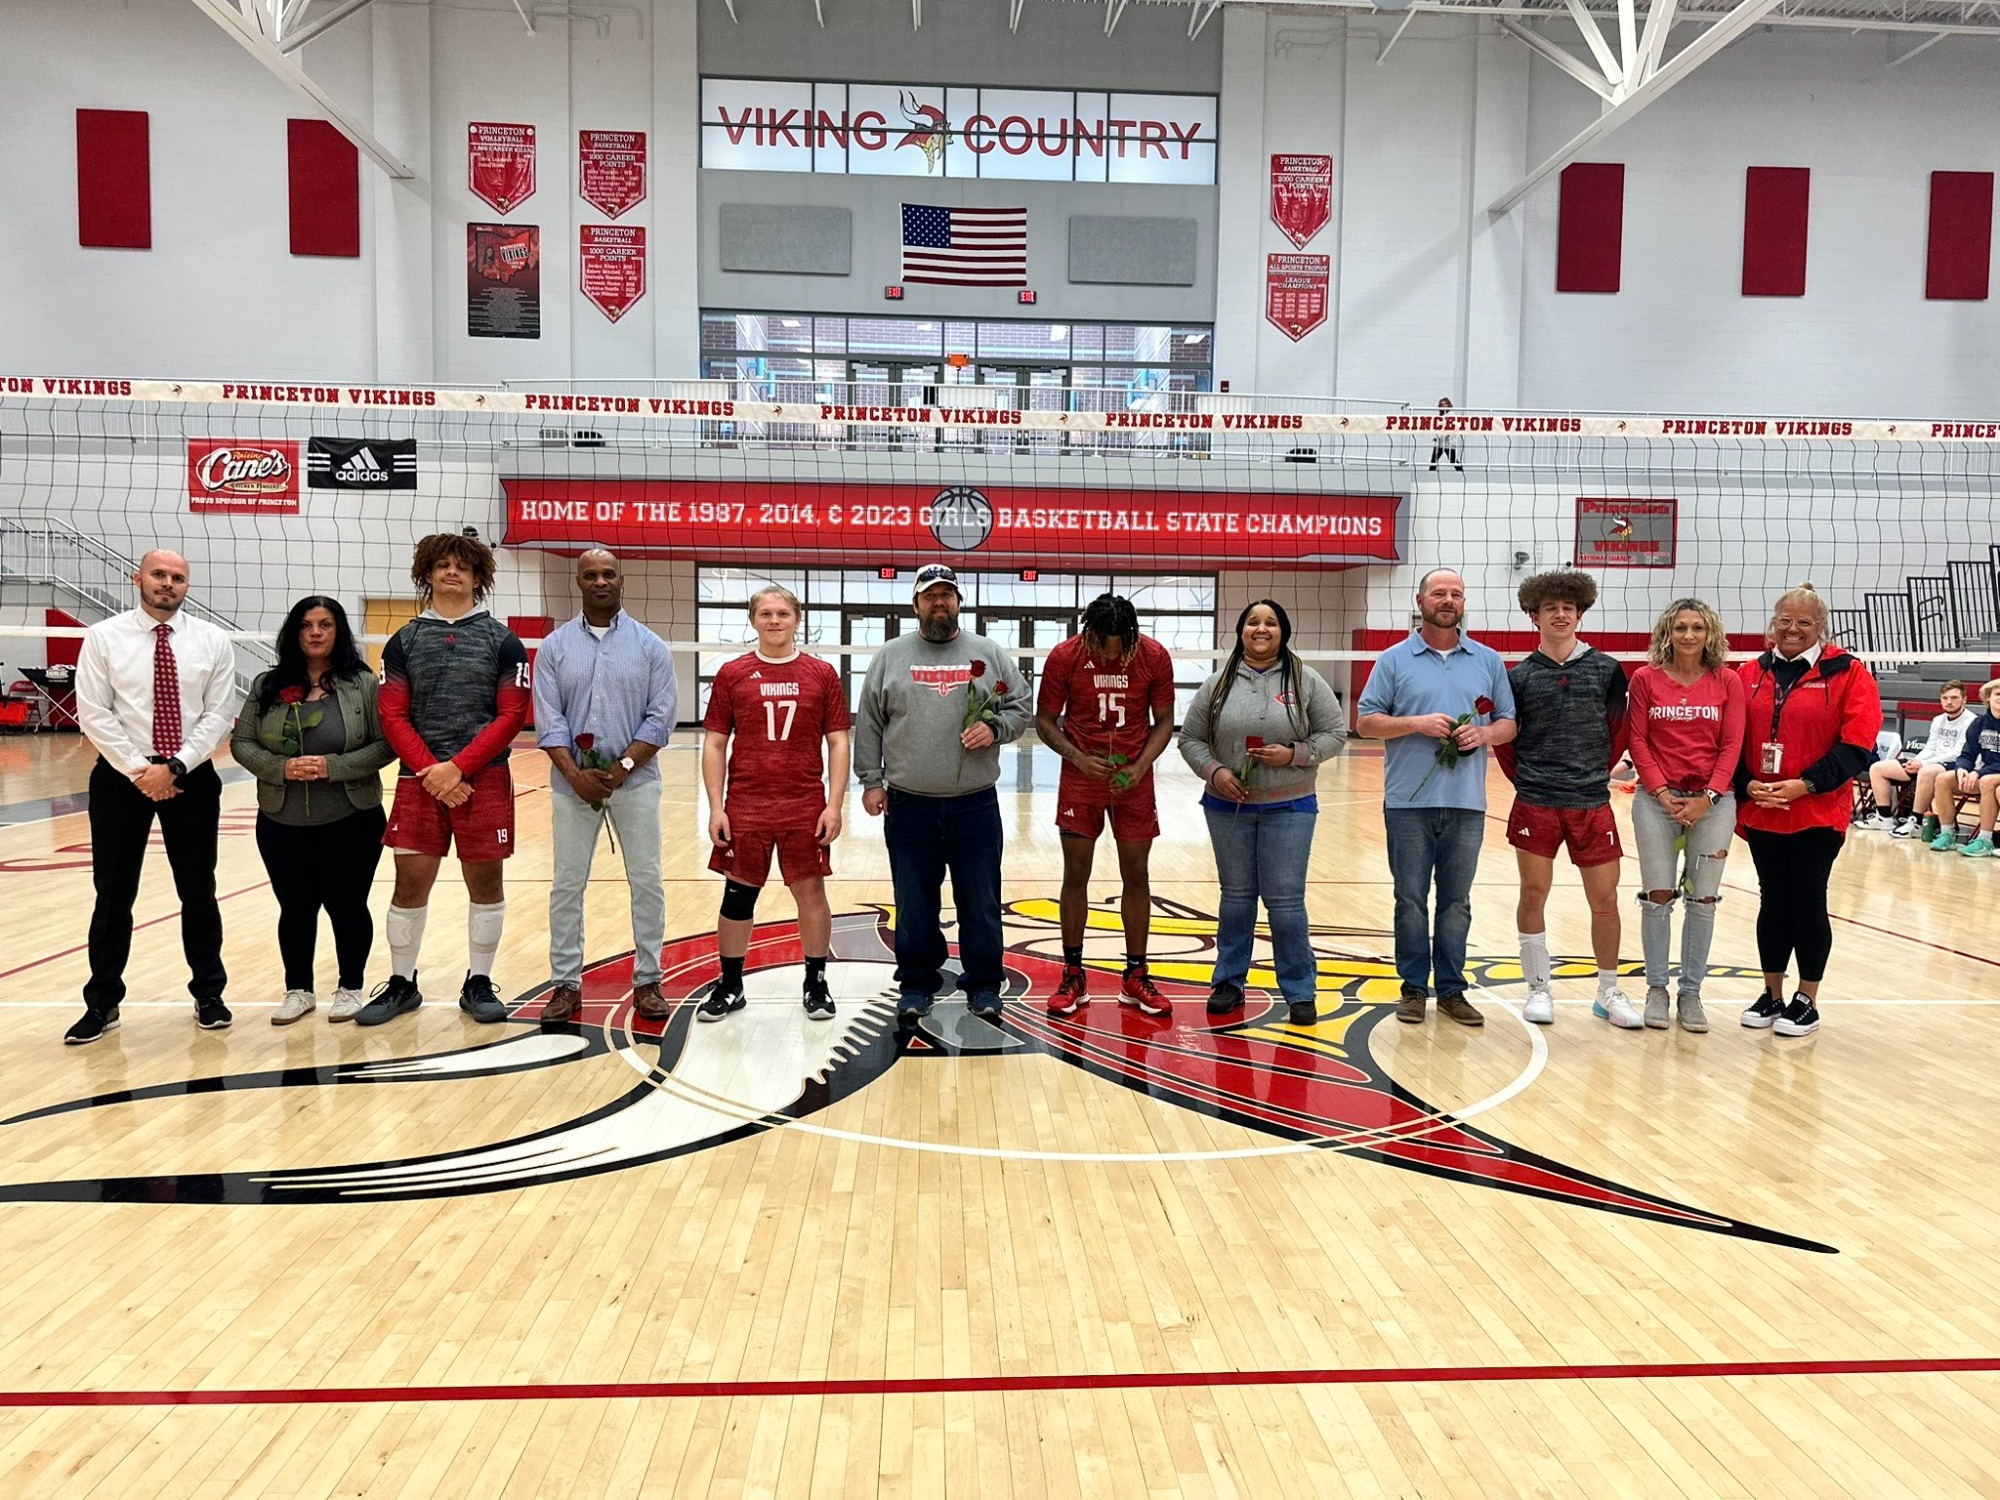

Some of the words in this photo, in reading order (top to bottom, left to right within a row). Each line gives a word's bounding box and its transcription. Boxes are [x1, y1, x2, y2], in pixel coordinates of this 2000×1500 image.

[478, 126, 525, 136] PRINCETON
[590, 133, 635, 143] PRINCETON
[718, 106, 888, 151] VIKING
[963, 114, 1202, 160] COUNTRY
[480, 135, 524, 143] VOLLEYBALL
[1280, 157, 1323, 166] PRINCETON
[590, 228, 636, 237] PRINCETON
[606, 248, 637, 256] CAREER
[1277, 255, 1321, 265] PRINCETON
[888, 287, 901, 298] EXIT
[1021, 291, 1034, 302] EXIT
[43, 378, 132, 396] VIKINGS
[223, 384, 339, 403] PRINCETON
[348, 388, 436, 406] VIKINGS
[525, 394, 640, 413] PRINCETON
[650, 398, 734, 416] VIKINGS
[821, 405, 931, 423] PRINCETON
[940, 408, 1022, 425] VIKINGS
[1105, 412, 1214, 429] PRINCETON
[1222, 414, 1303, 429] VIKINGS
[1386, 416, 1493, 431] PRINCETON
[1502, 417, 1581, 432] VIKINGS
[1662, 420, 1767, 435] PRINCETON
[1775, 421, 1852, 436] VIKINGS
[1931, 424, 2000, 438] PRINCE
[232, 451, 264, 460] Raising
[202, 449, 289, 489] Cane's
[335, 468, 389, 482] adidas
[215, 497, 247, 505] SPONSOR
[258, 499, 297, 507] PRINCETON
[521, 500, 589, 521] HOME
[596, 501, 625, 521] OF
[632, 501, 681, 522] THE
[688, 503, 752, 527] 1987,
[759, 504, 821, 527] 2014,
[828, 504, 843, 525] &
[851, 505, 911, 526] 2023
[919, 506, 991, 528] GIRLS
[998, 507, 1160, 532] BASKETBALL
[1166, 512, 1240, 533] STATE
[1246, 514, 1382, 536] CHAMPIONS
[881, 568, 895, 578] EXIT
[1023, 570, 1037, 580] EXIT
[515, 662, 531, 689] 19
[1093, 674, 1129, 688] VIKINGS
[760, 682, 800, 697] VIKINGS
[1097, 692, 1126, 728] 15
[763, 700, 798, 742] 17
[496, 828, 508, 844] 19
